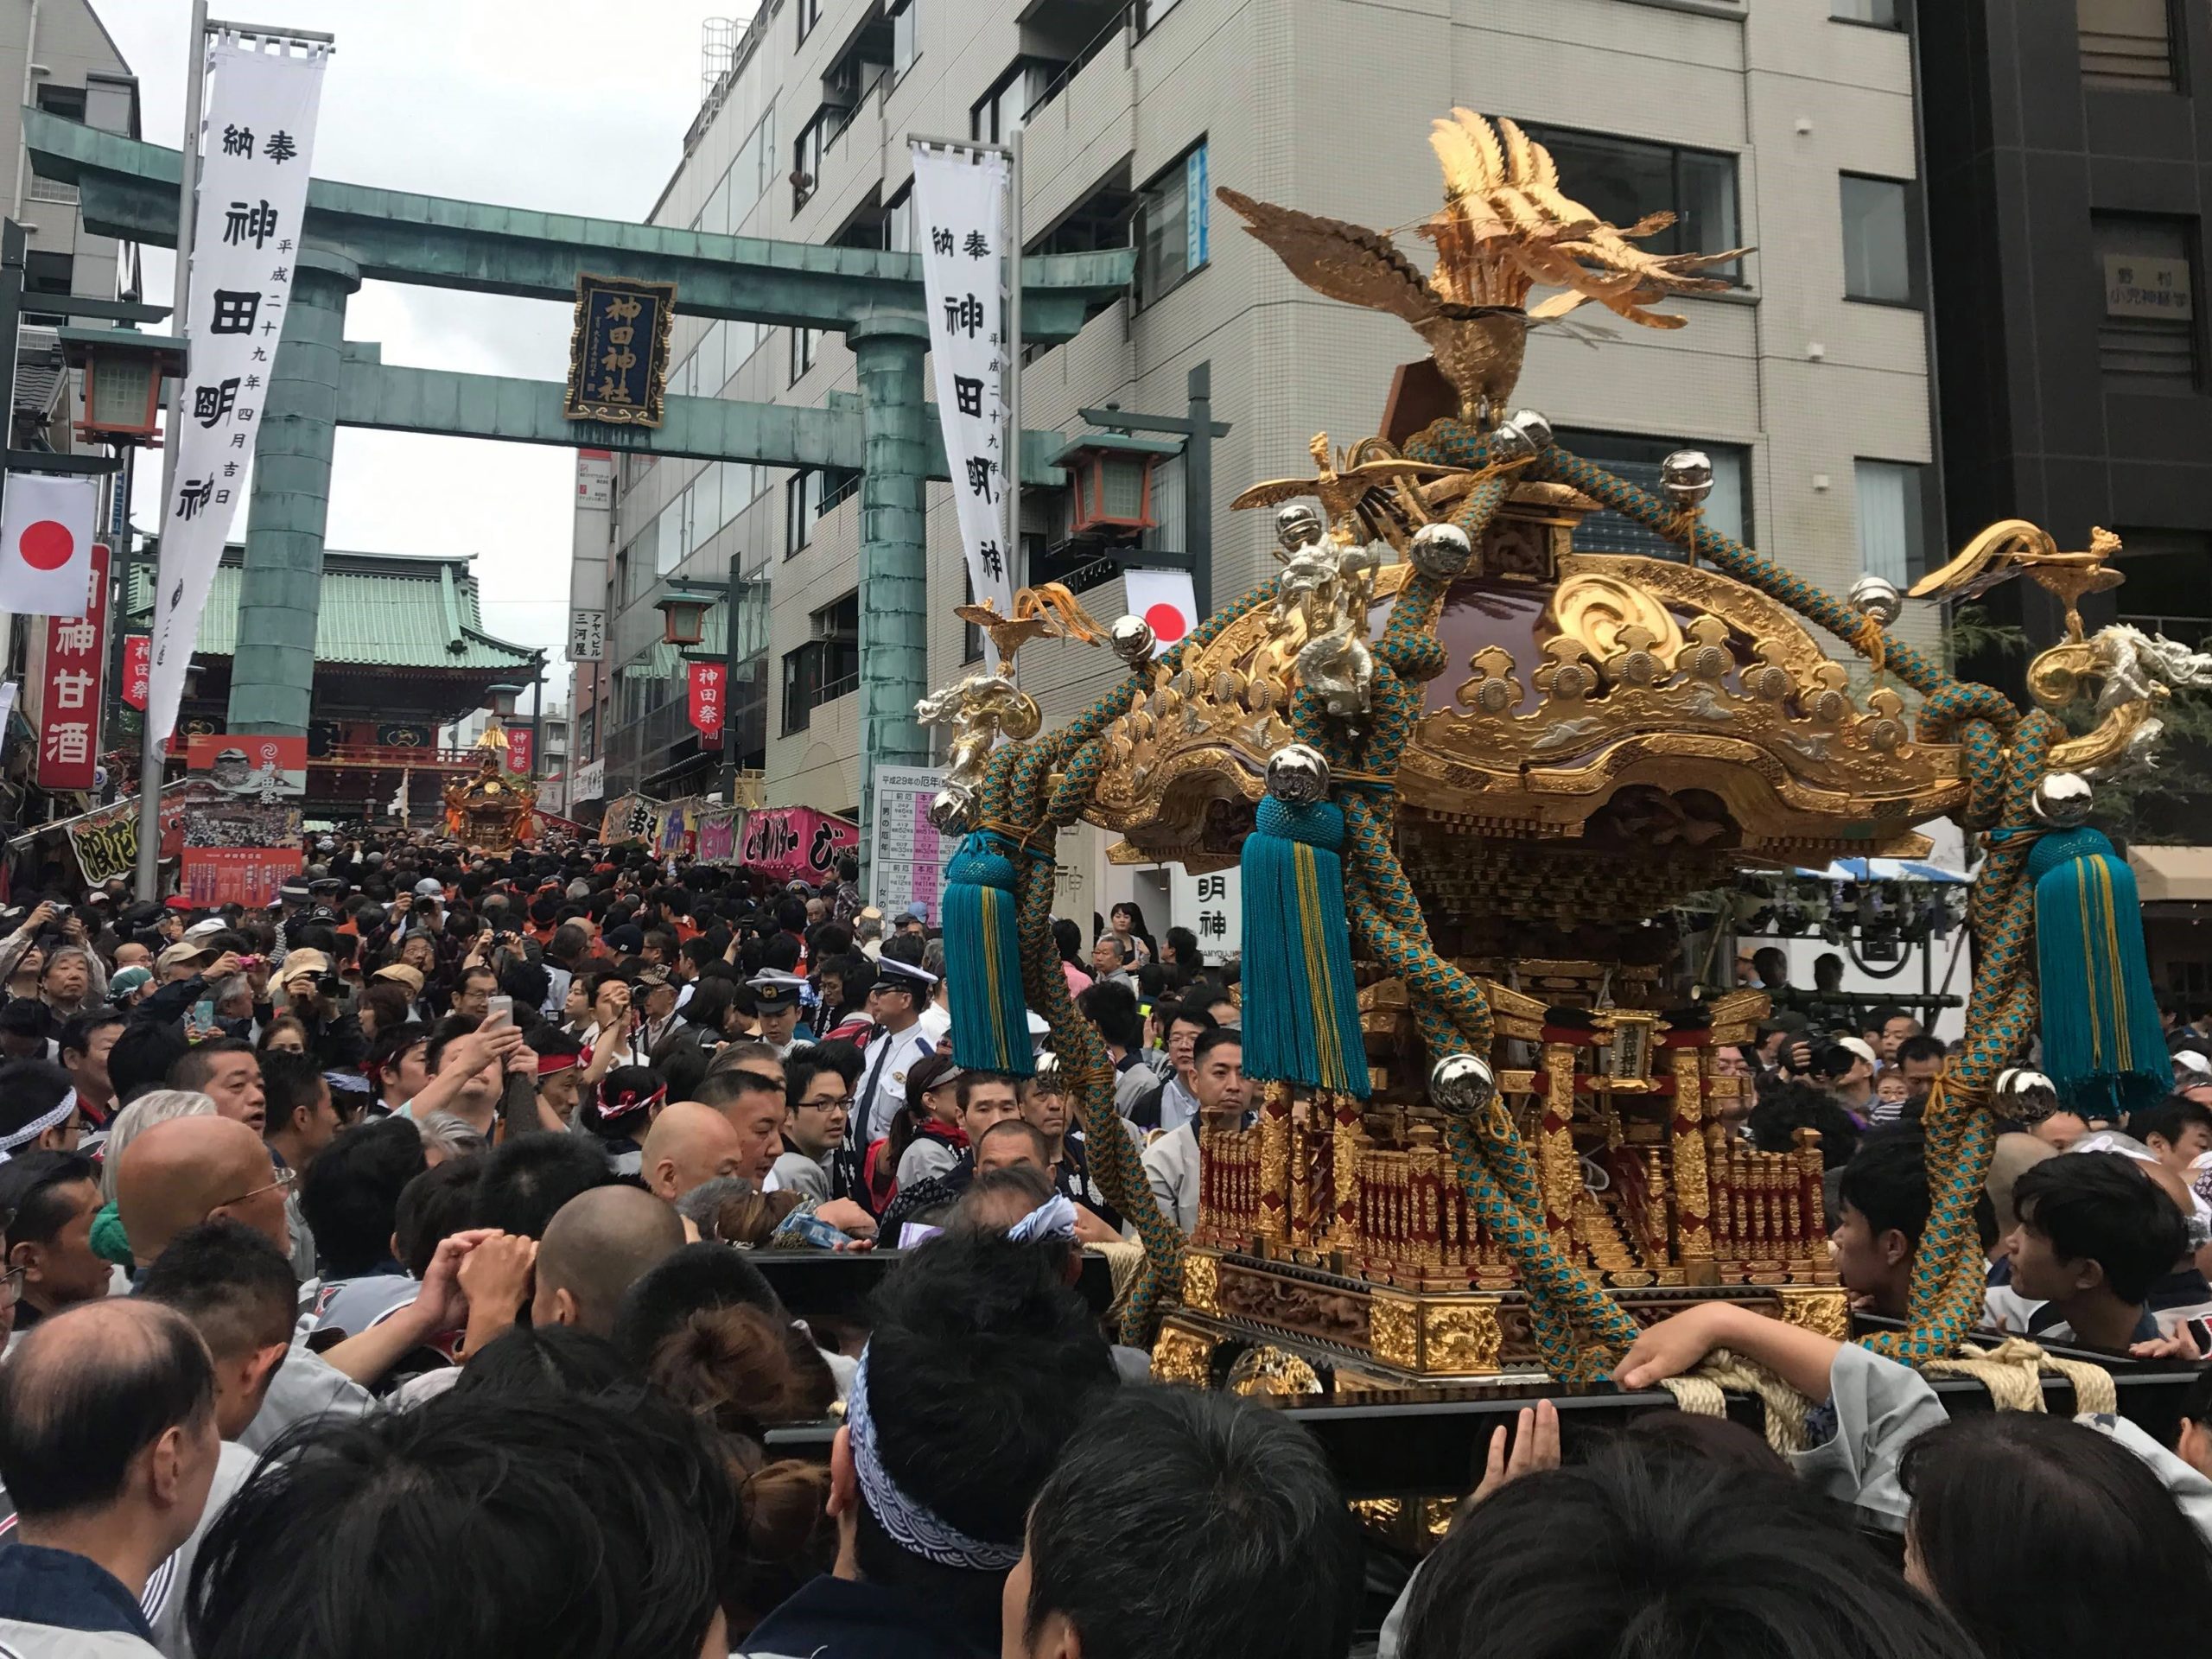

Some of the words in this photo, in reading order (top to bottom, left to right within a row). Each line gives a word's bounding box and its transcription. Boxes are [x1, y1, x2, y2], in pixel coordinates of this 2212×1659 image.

[222, 124, 297, 165] 奉納
[932, 226, 991, 261] 奉納
[215, 238, 293, 505] 平成二十九年四月吉日
[597, 296, 643, 404] 神田神社
[987, 332, 1001, 505] 平成二十九年
[574, 613, 588, 656] 三河屋
[591, 613, 602, 657] アヤベビル
[699, 668, 718, 724] 神田祭
[512, 732, 527, 768] 神田祭
[260, 760, 276, 804] 神田祭
[1198, 875, 1227, 942] 明神
